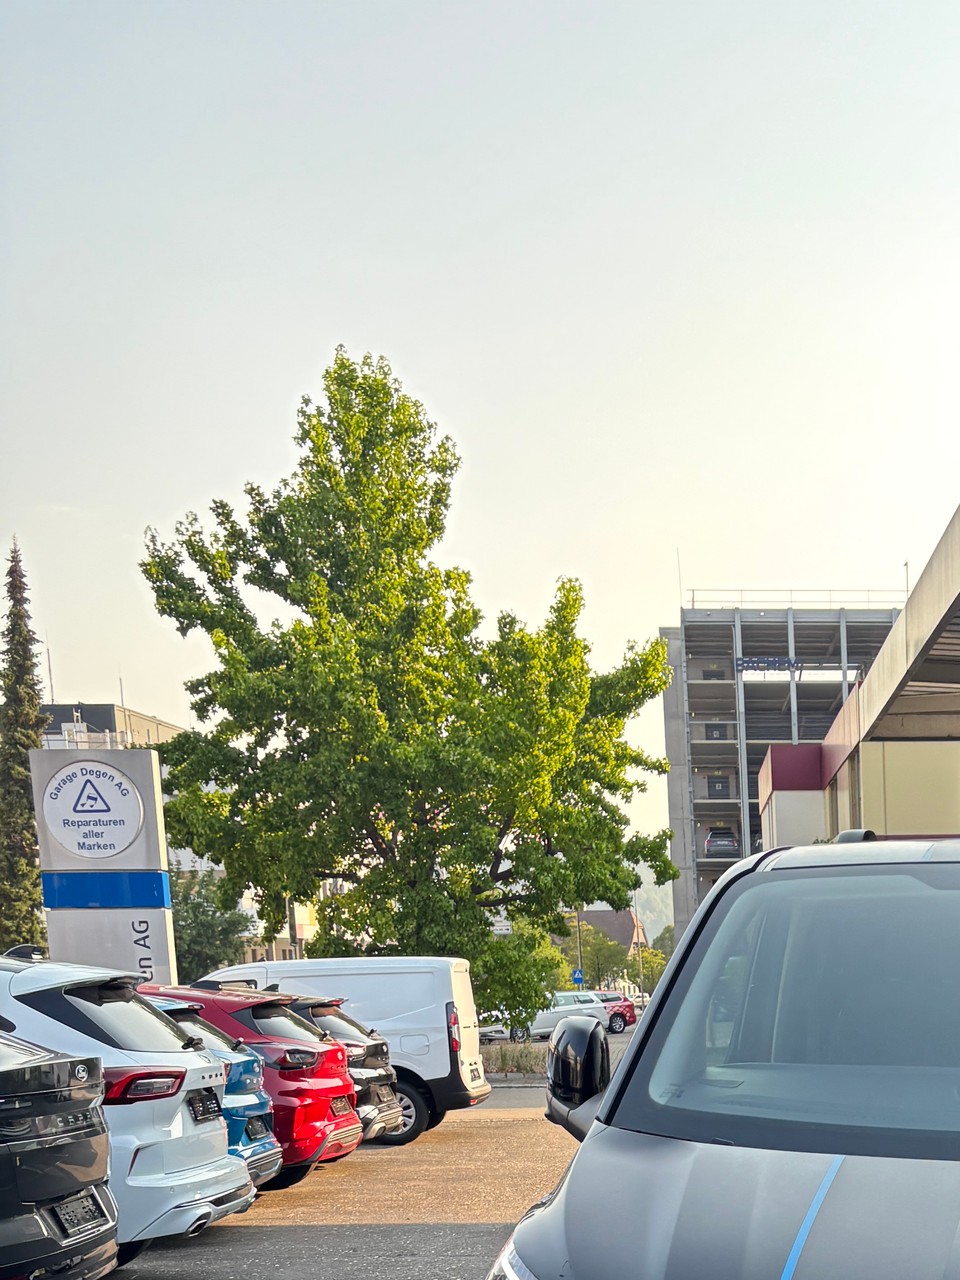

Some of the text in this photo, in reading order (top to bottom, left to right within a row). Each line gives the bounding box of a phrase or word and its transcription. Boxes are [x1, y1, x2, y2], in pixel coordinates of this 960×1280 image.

[49, 767, 130, 801] Garage Degen AG
[62, 818, 126, 829] Reparaturen
[82, 829, 105, 839] aller
[77, 841, 116, 851] Marken
[131, 920, 152, 950] AG
